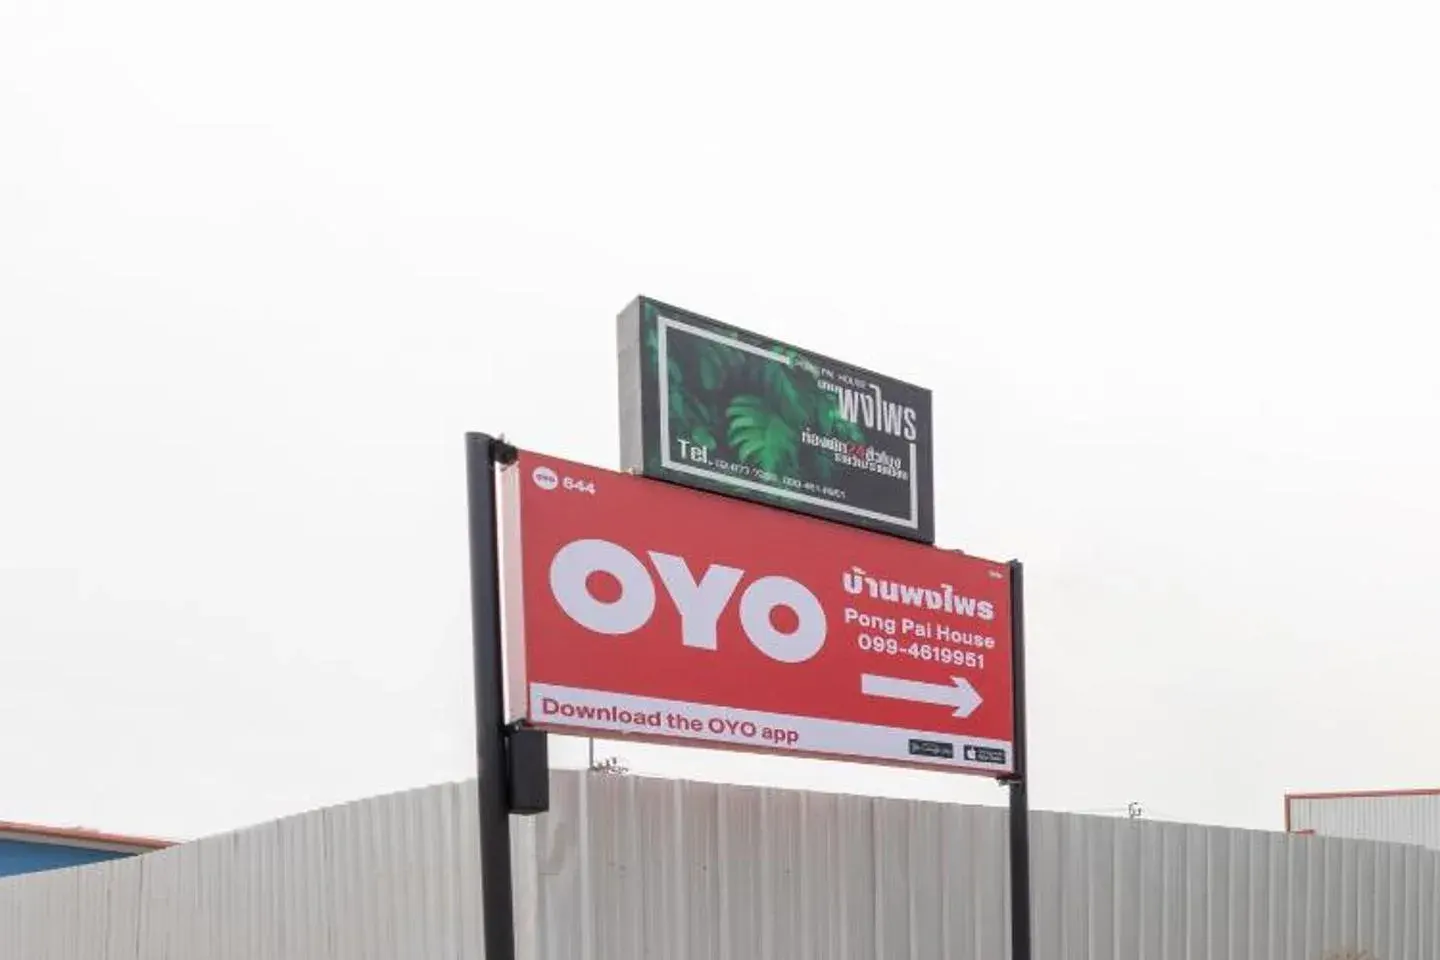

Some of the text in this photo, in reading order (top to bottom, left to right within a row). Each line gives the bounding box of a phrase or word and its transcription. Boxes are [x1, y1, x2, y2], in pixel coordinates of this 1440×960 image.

[549, 538, 828, 664] OYO
[843, 566, 995, 620] บ้านพงไพร
[844, 607, 996, 649] Pong Pai House
[857, 633, 985, 669] 099-4619951
[542, 697, 800, 745] Download the OYO app
